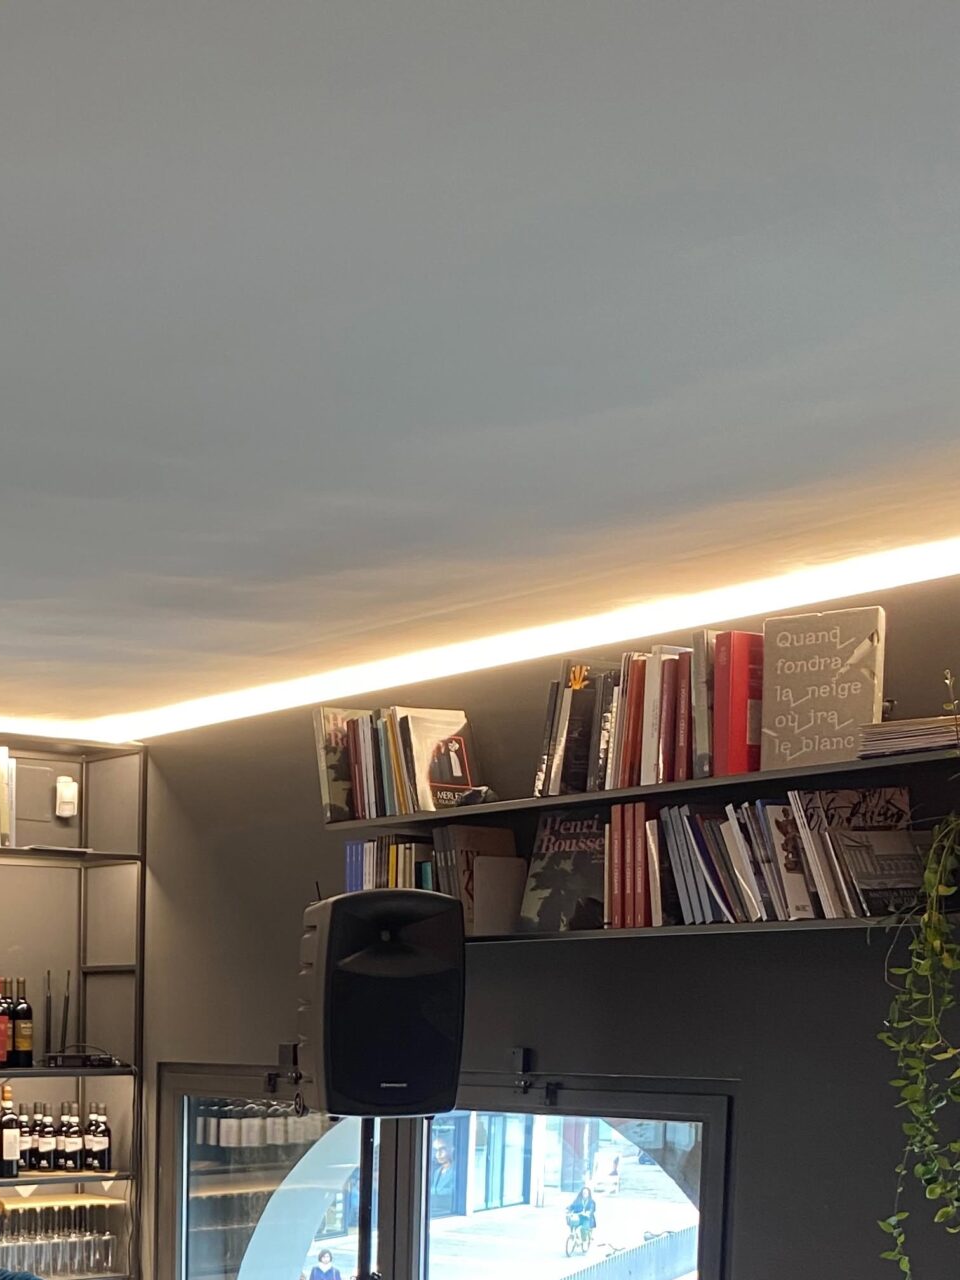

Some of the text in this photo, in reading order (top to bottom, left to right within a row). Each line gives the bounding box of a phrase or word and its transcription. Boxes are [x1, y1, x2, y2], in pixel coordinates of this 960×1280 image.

[776, 626, 842, 648] Quand
[776, 656, 843, 674] fondra
[775, 679, 861, 703] la neige
[775, 709, 839, 731] où ira
[774, 735, 854, 755] le blanc
[544, 814, 602, 834] Henri
[540, 835, 604, 854] Rousse
